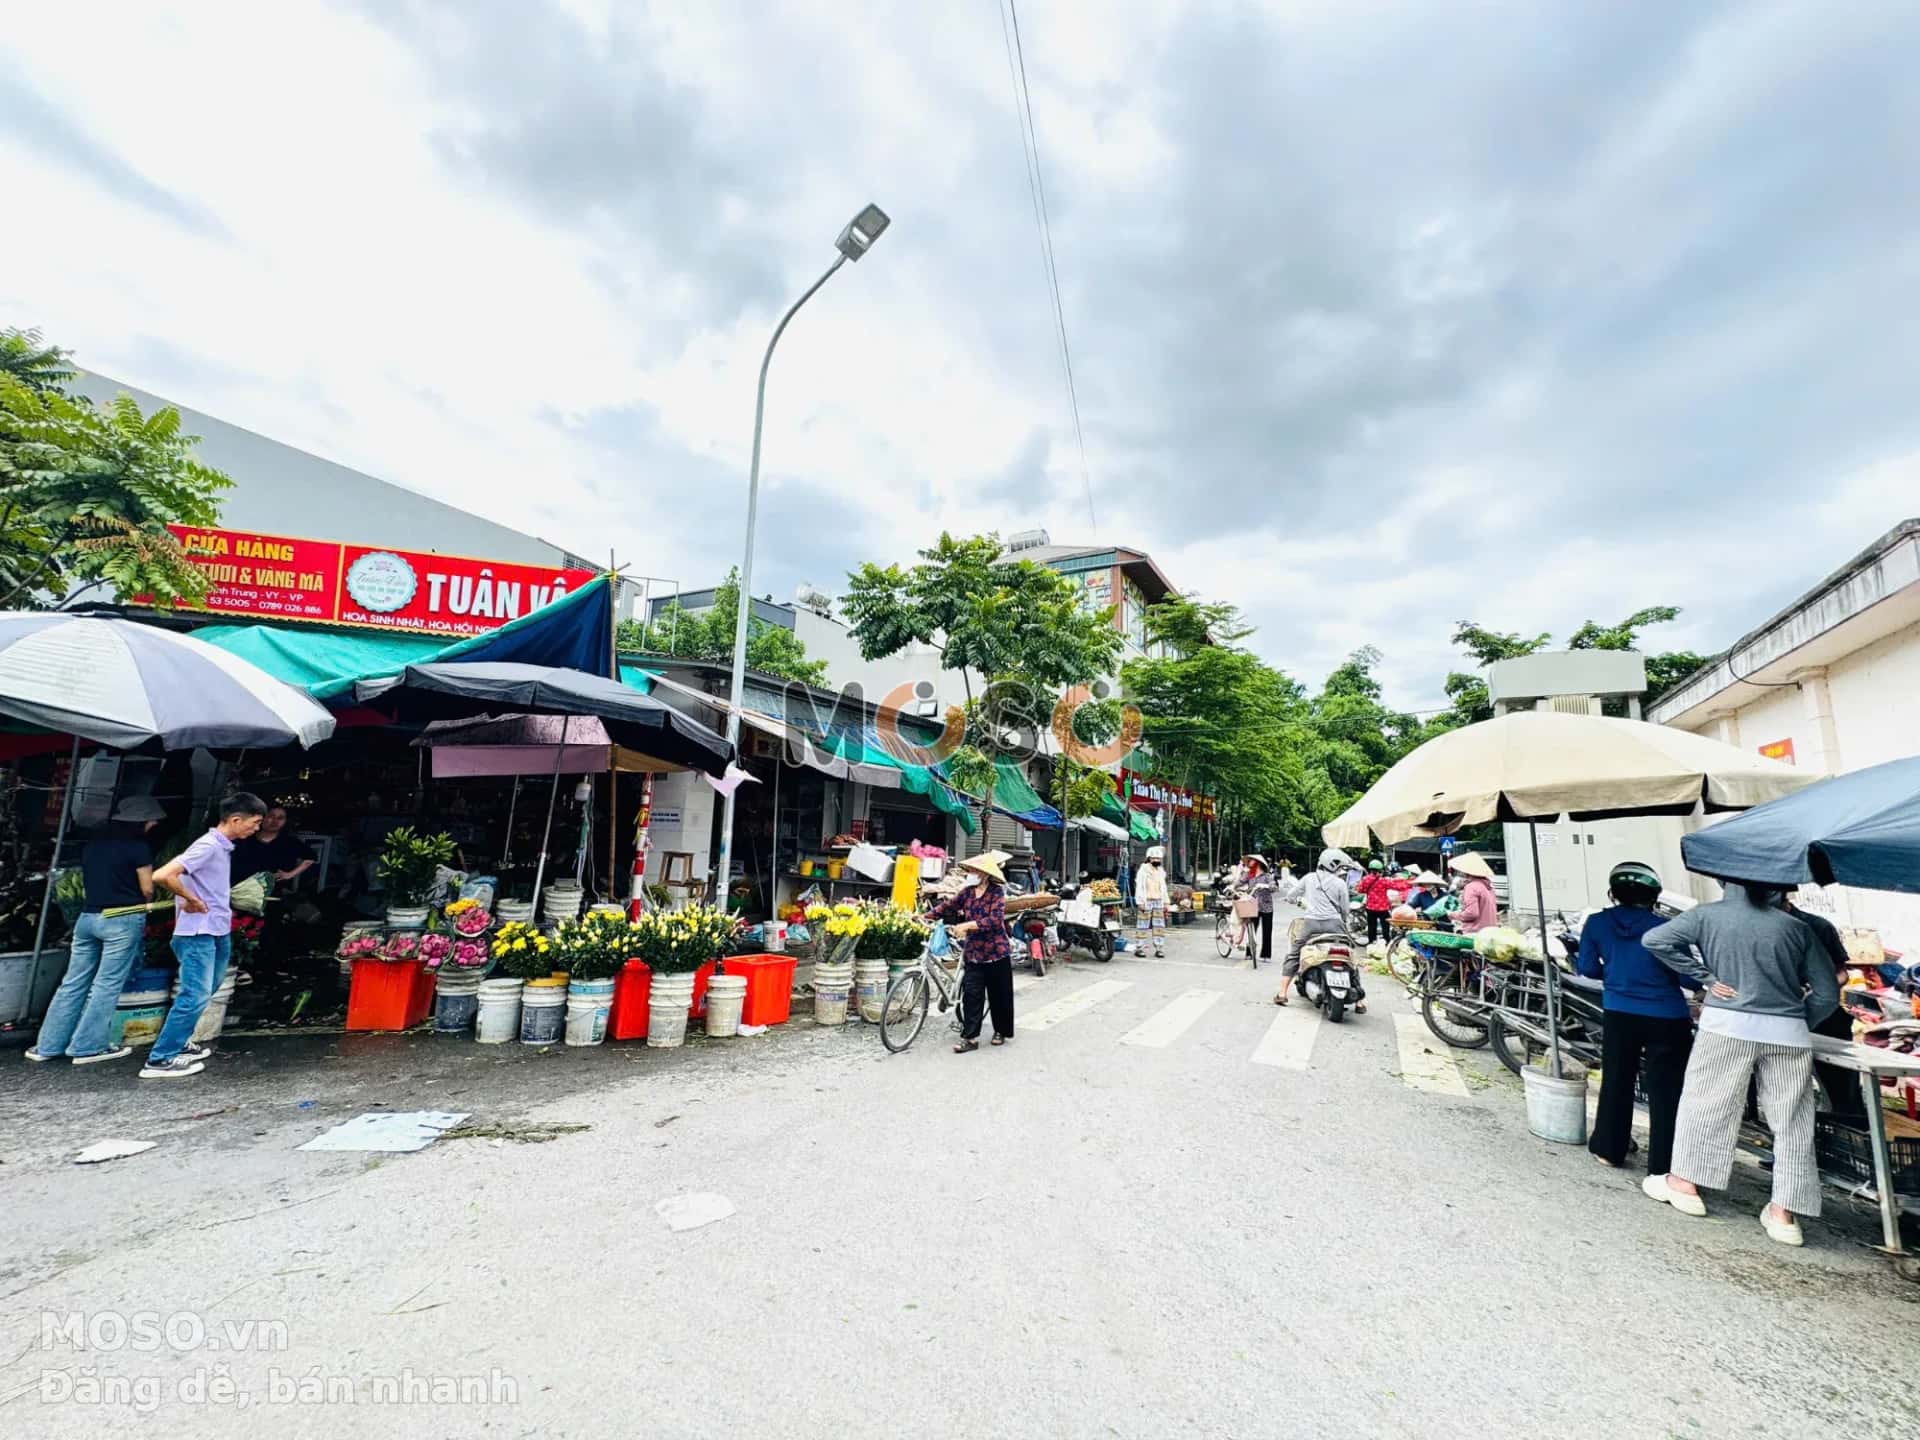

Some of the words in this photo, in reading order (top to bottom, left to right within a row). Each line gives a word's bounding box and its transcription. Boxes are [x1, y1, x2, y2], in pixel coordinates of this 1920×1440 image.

[235, 537, 295, 562] HÀNG
[239, 567, 252, 585] &
[255, 566, 296, 589] VÀNG
[299, 570, 324, 591] MÃ
[231, 587, 258, 599] Trung
[265, 591, 280, 599] VY
[289, 593, 304, 601] VP
[530, 576, 567, 613] VÂ
[342, 611, 368, 622] HOA
[369, 614, 396, 625] SINH
[428, 620, 452, 630] HOA
